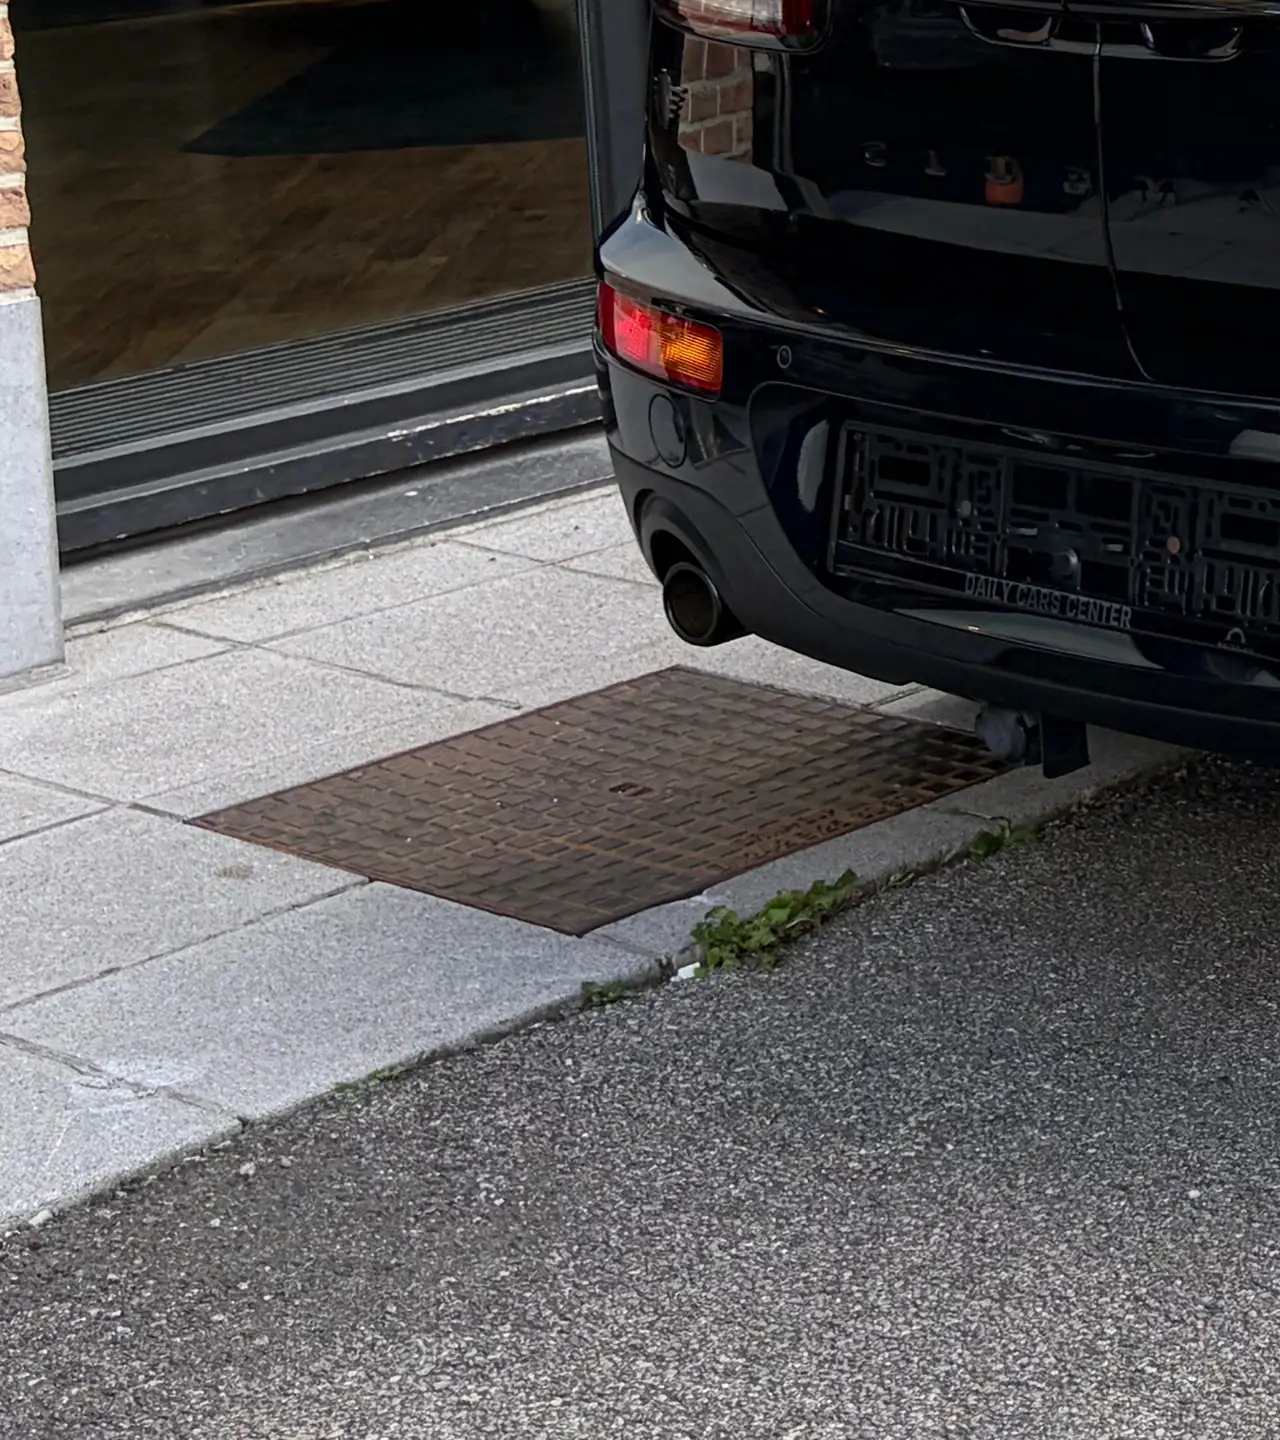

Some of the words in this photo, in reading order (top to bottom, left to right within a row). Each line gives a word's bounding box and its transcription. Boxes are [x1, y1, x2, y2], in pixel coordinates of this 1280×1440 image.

[964, 572, 1012, 604] DAILY
[1015, 582, 1062, 614] CARS
[1066, 595, 1133, 629] CENTER
